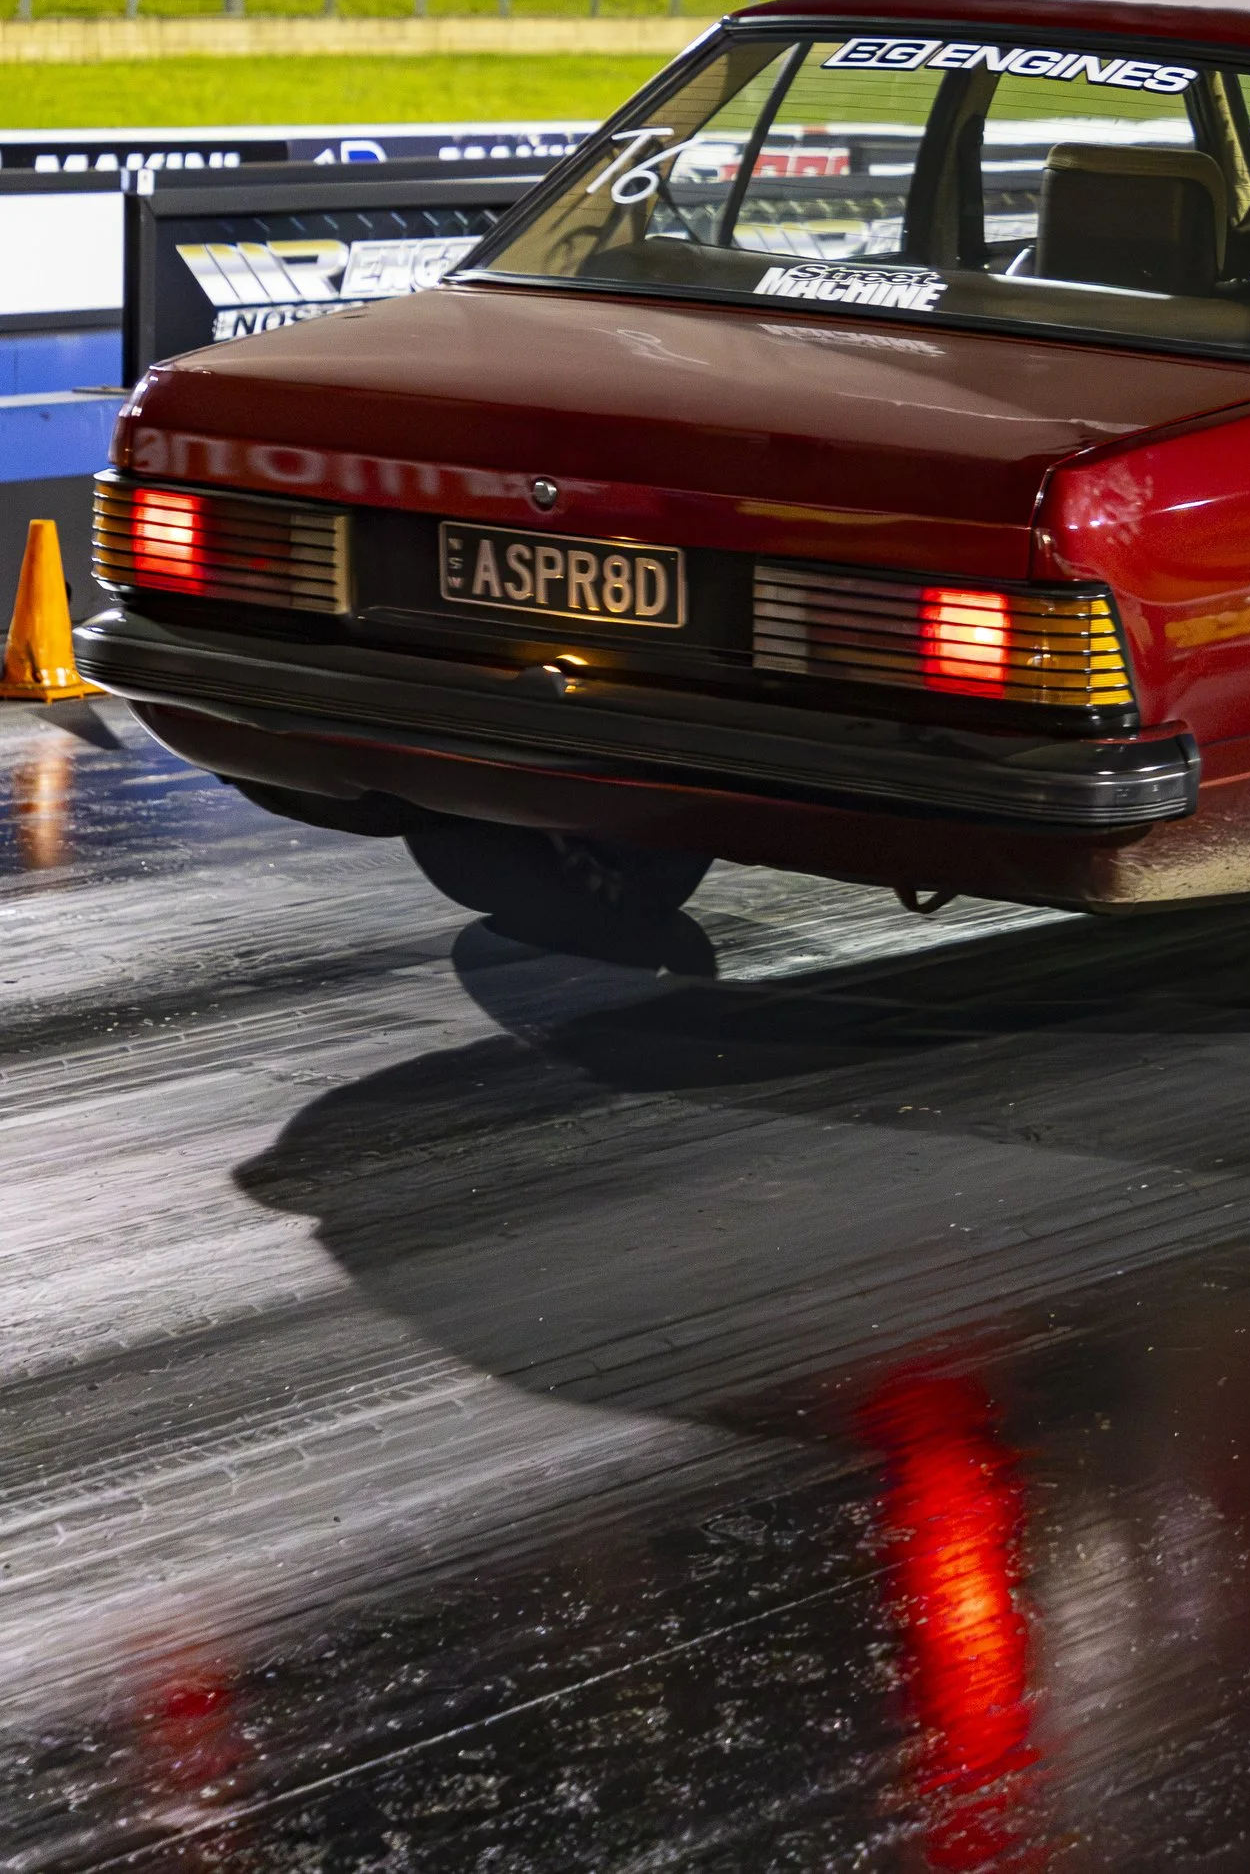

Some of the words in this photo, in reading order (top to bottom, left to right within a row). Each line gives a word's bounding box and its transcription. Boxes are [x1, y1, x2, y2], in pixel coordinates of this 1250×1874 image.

[829, 39, 934, 67] BG
[933, 43, 1198, 92] ENGINES
[753, 267, 949, 312] MACHINE
[789, 263, 942, 287] Street
[472, 539, 669, 616] ASPR8D
